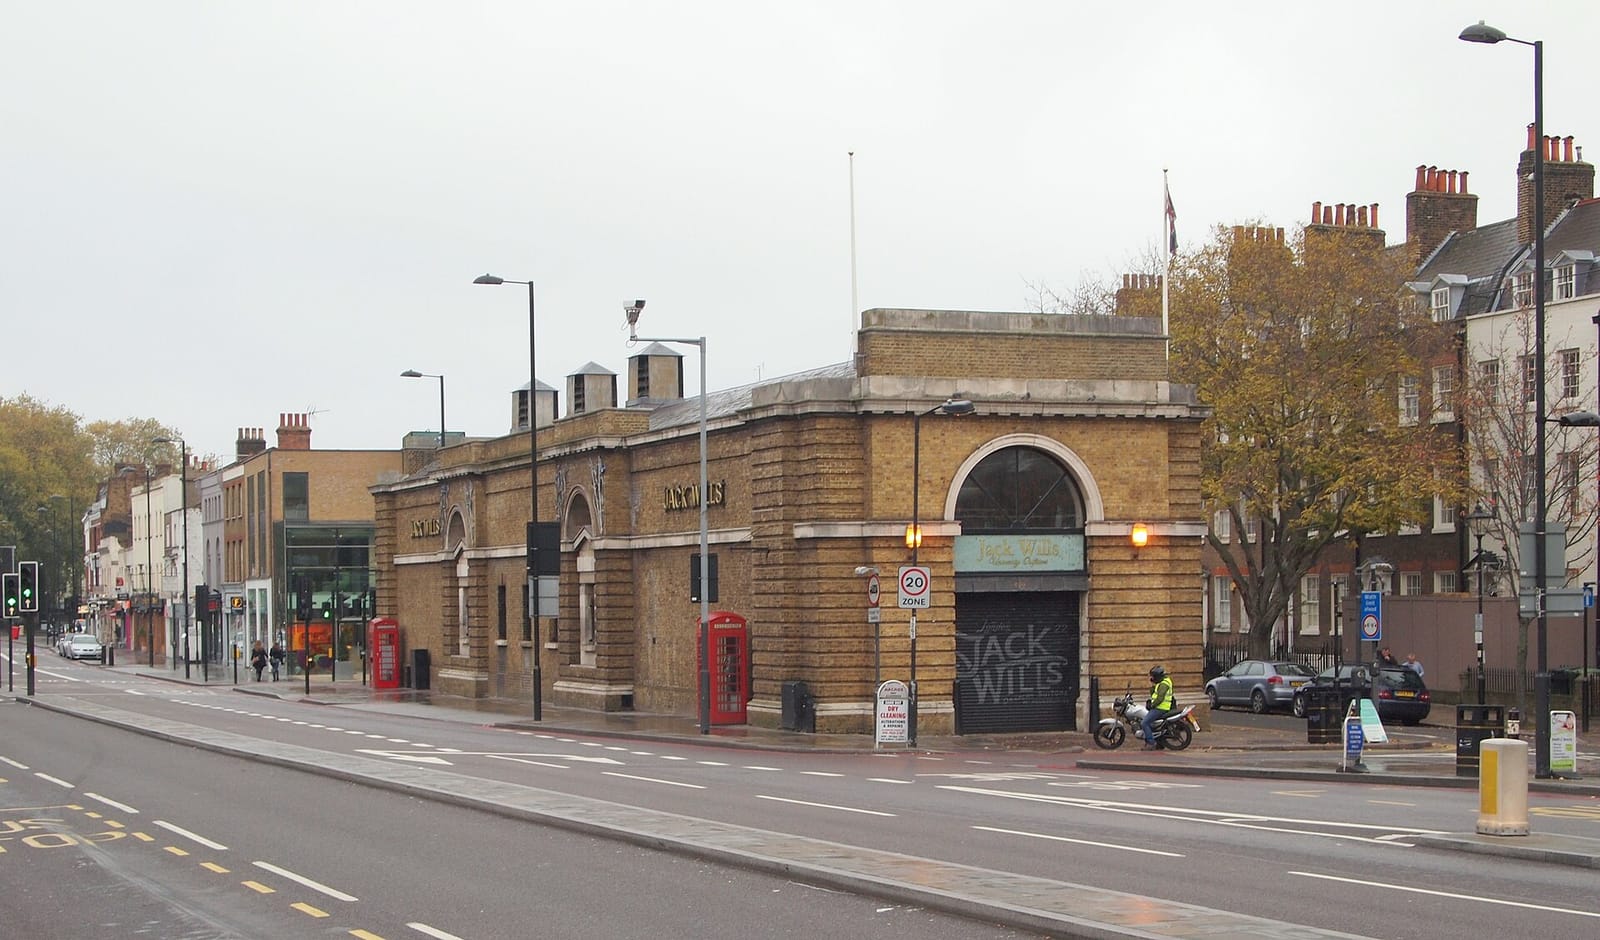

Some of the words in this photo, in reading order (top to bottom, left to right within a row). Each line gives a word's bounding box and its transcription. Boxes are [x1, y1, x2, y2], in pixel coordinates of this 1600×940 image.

[664, 486, 688, 509] JACK
[978, 538, 1015, 562] Jack
[1018, 537, 1060, 557] Wills
[905, 576, 924, 588] 20
[902, 598, 926, 606] ZONE
[956, 624, 1051, 678] JACK
[972, 662, 1064, 704] WILLS
